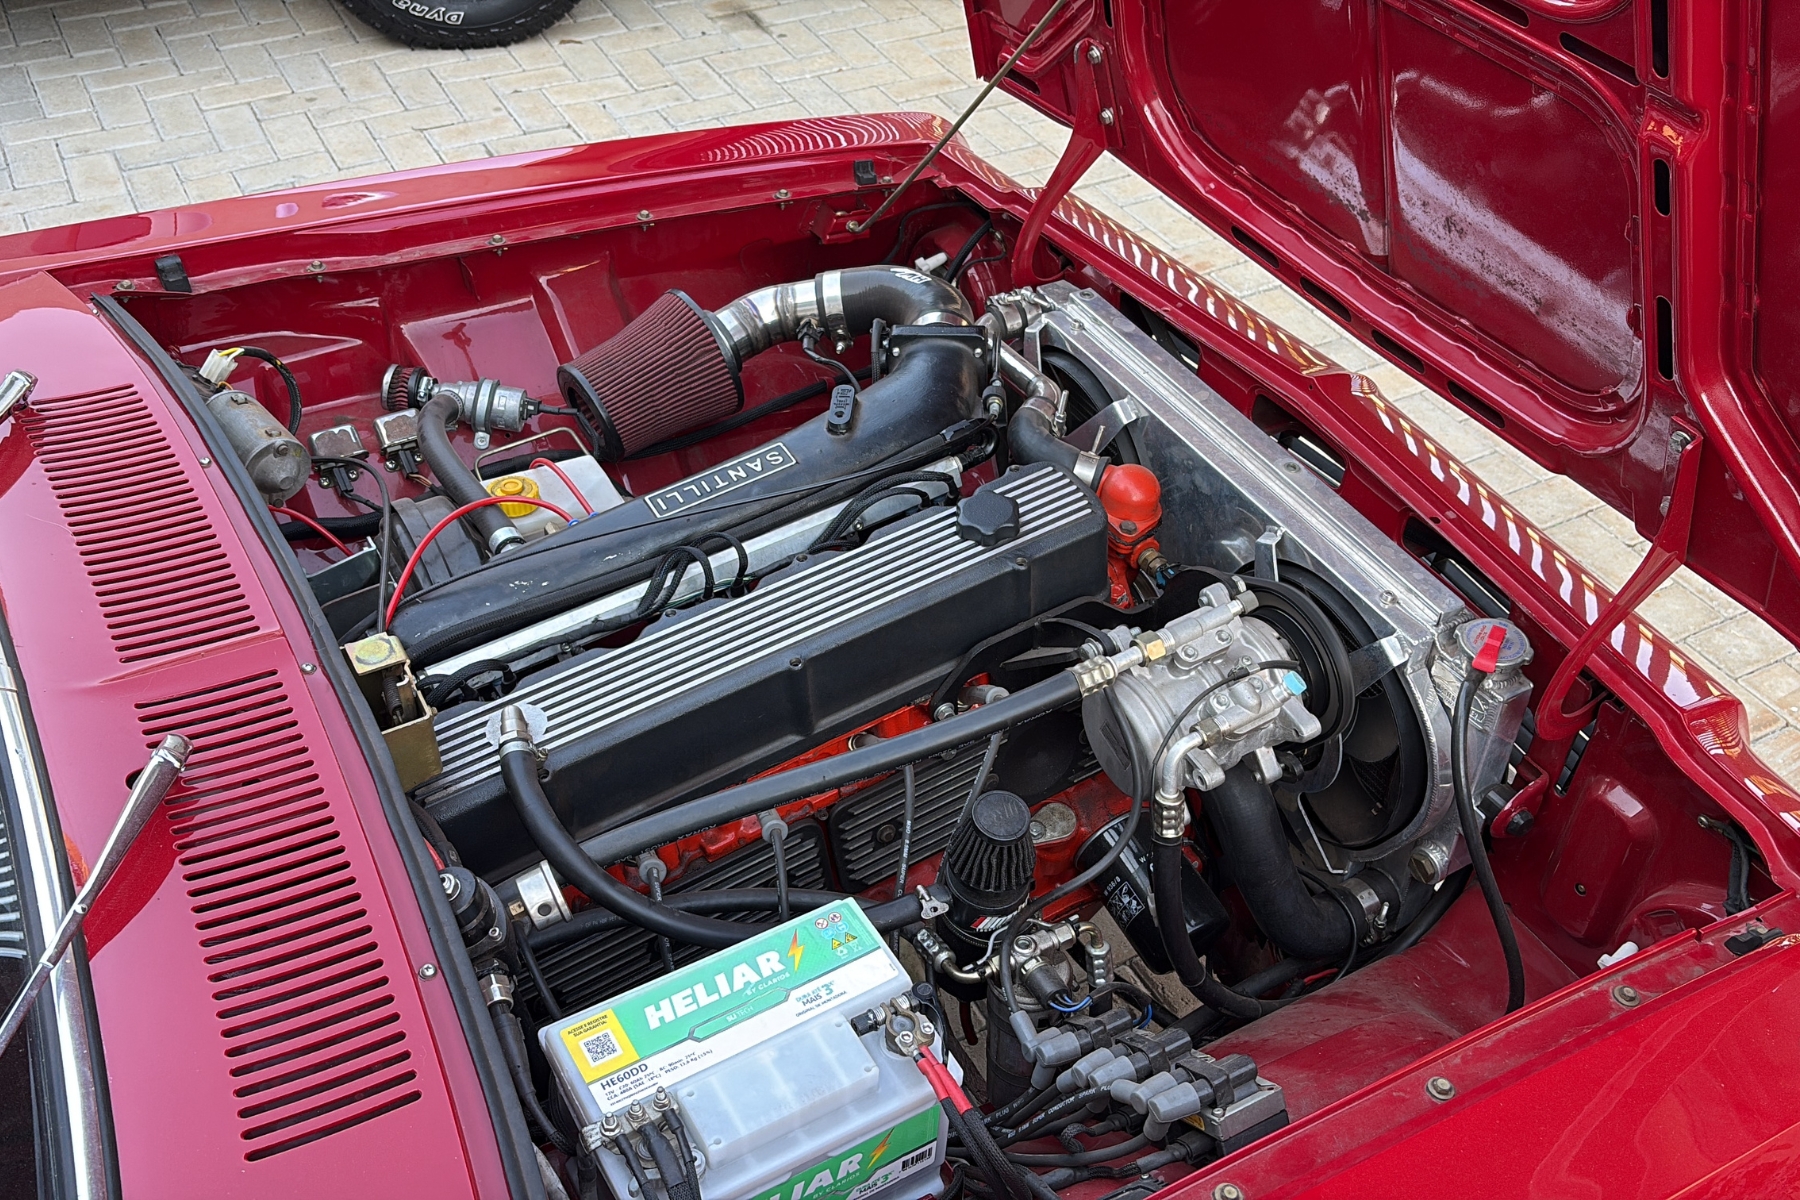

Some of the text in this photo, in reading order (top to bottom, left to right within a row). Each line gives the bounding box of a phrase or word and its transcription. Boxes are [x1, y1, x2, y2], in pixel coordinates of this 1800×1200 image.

[656, 451, 784, 510] SANTILLI
[644, 951, 787, 1031] HELIAR
[757, 972, 791, 991] CLARIOS
[801, 993, 823, 1007] MAIS
[600, 1063, 649, 1091] HE60DD
[1047, 1095, 1076, 1115] CONDUCTOR
[1078, 1087, 1097, 1099] SPARK
[995, 1107, 1010, 1119] PLUG
[825, 1171, 861, 1194] CLARIOS
[859, 1182, 878, 1195] MAIS
